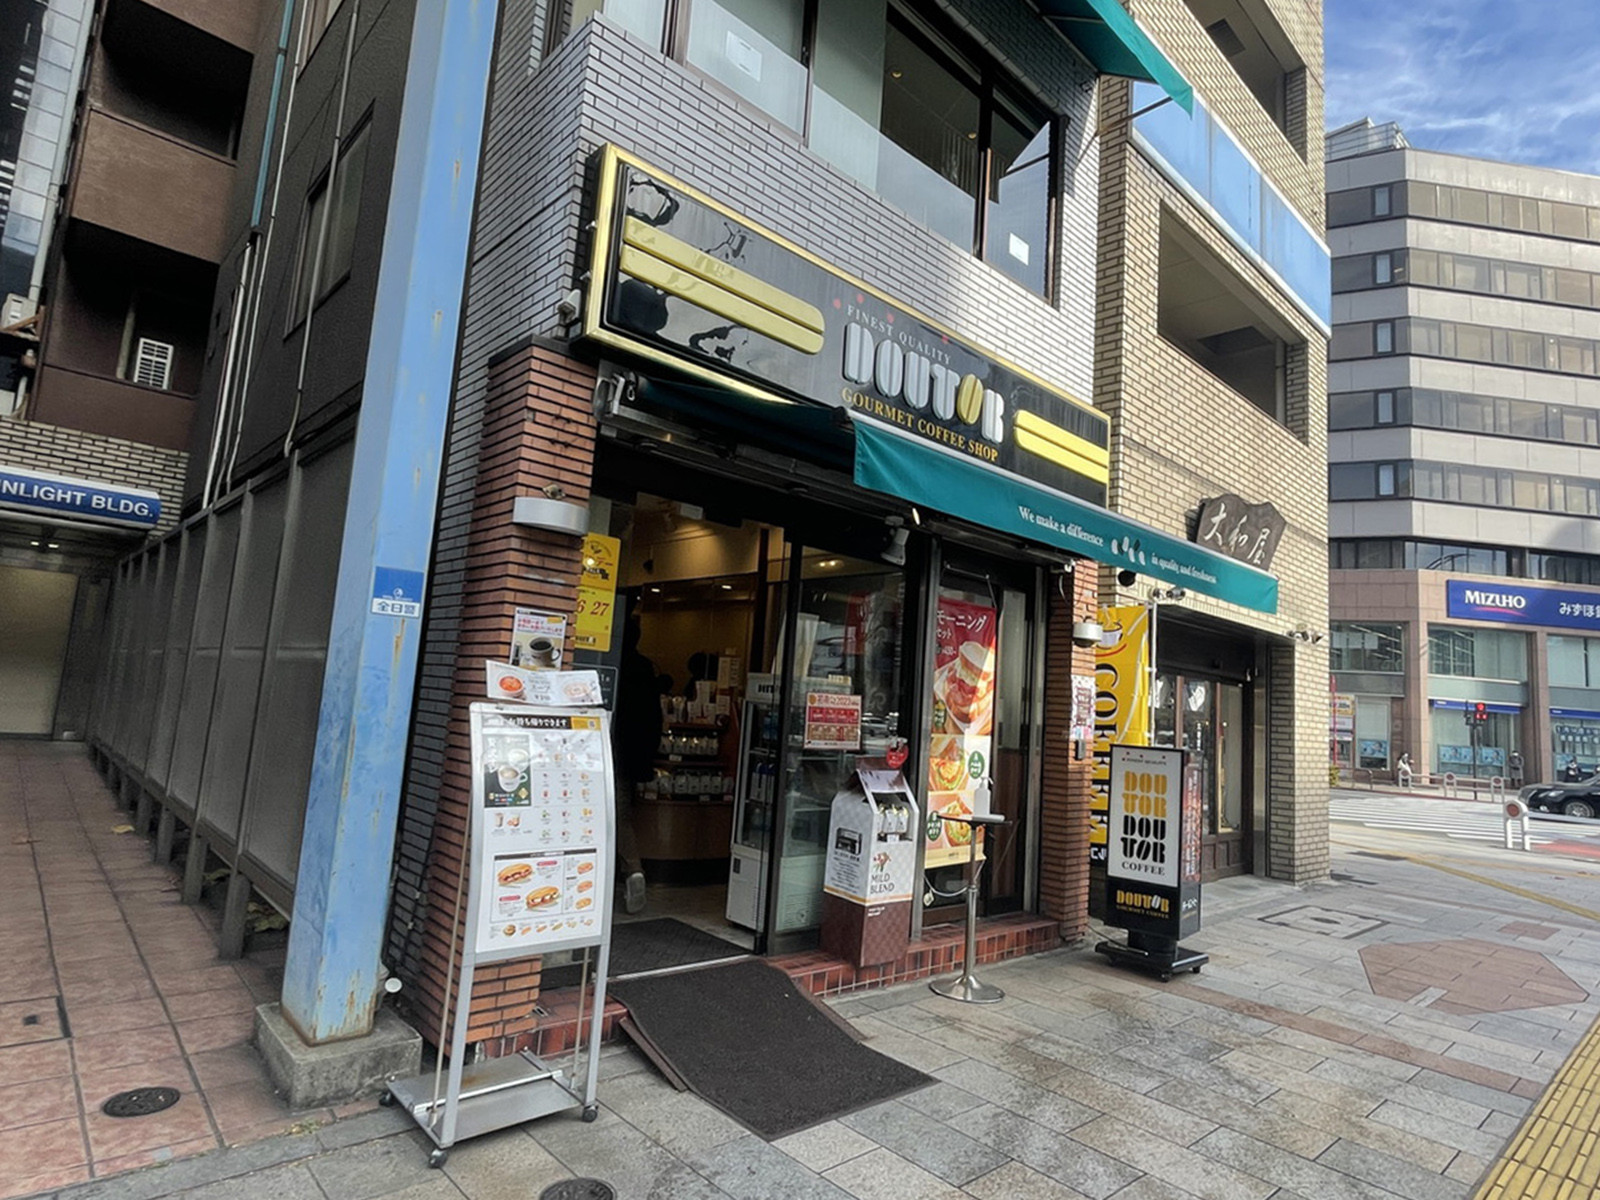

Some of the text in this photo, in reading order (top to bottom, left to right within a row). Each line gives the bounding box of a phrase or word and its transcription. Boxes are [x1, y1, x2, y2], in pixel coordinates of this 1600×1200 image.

[847, 304, 952, 365] FINEST QUALITY
[843, 321, 1004, 444] DOUTOR
[841, 387, 999, 463] GOURMET COFFEE SHOP
[91, 494, 153, 518] BLDG.
[1018, 505, 1105, 548] We make a difference
[590, 601, 610, 616] 27
[1464, 590, 1526, 609] MIZUHO
[1124, 771, 1167, 795] DOU
[1122, 793, 1167, 818] TOR
[1122, 815, 1166, 840] DOU
[1120, 836, 1166, 864] TOR
[1121, 861, 1165, 876] COFFEE
[869, 883, 895, 894] BLEND
[1116, 889, 1169, 913] DOUTOR
